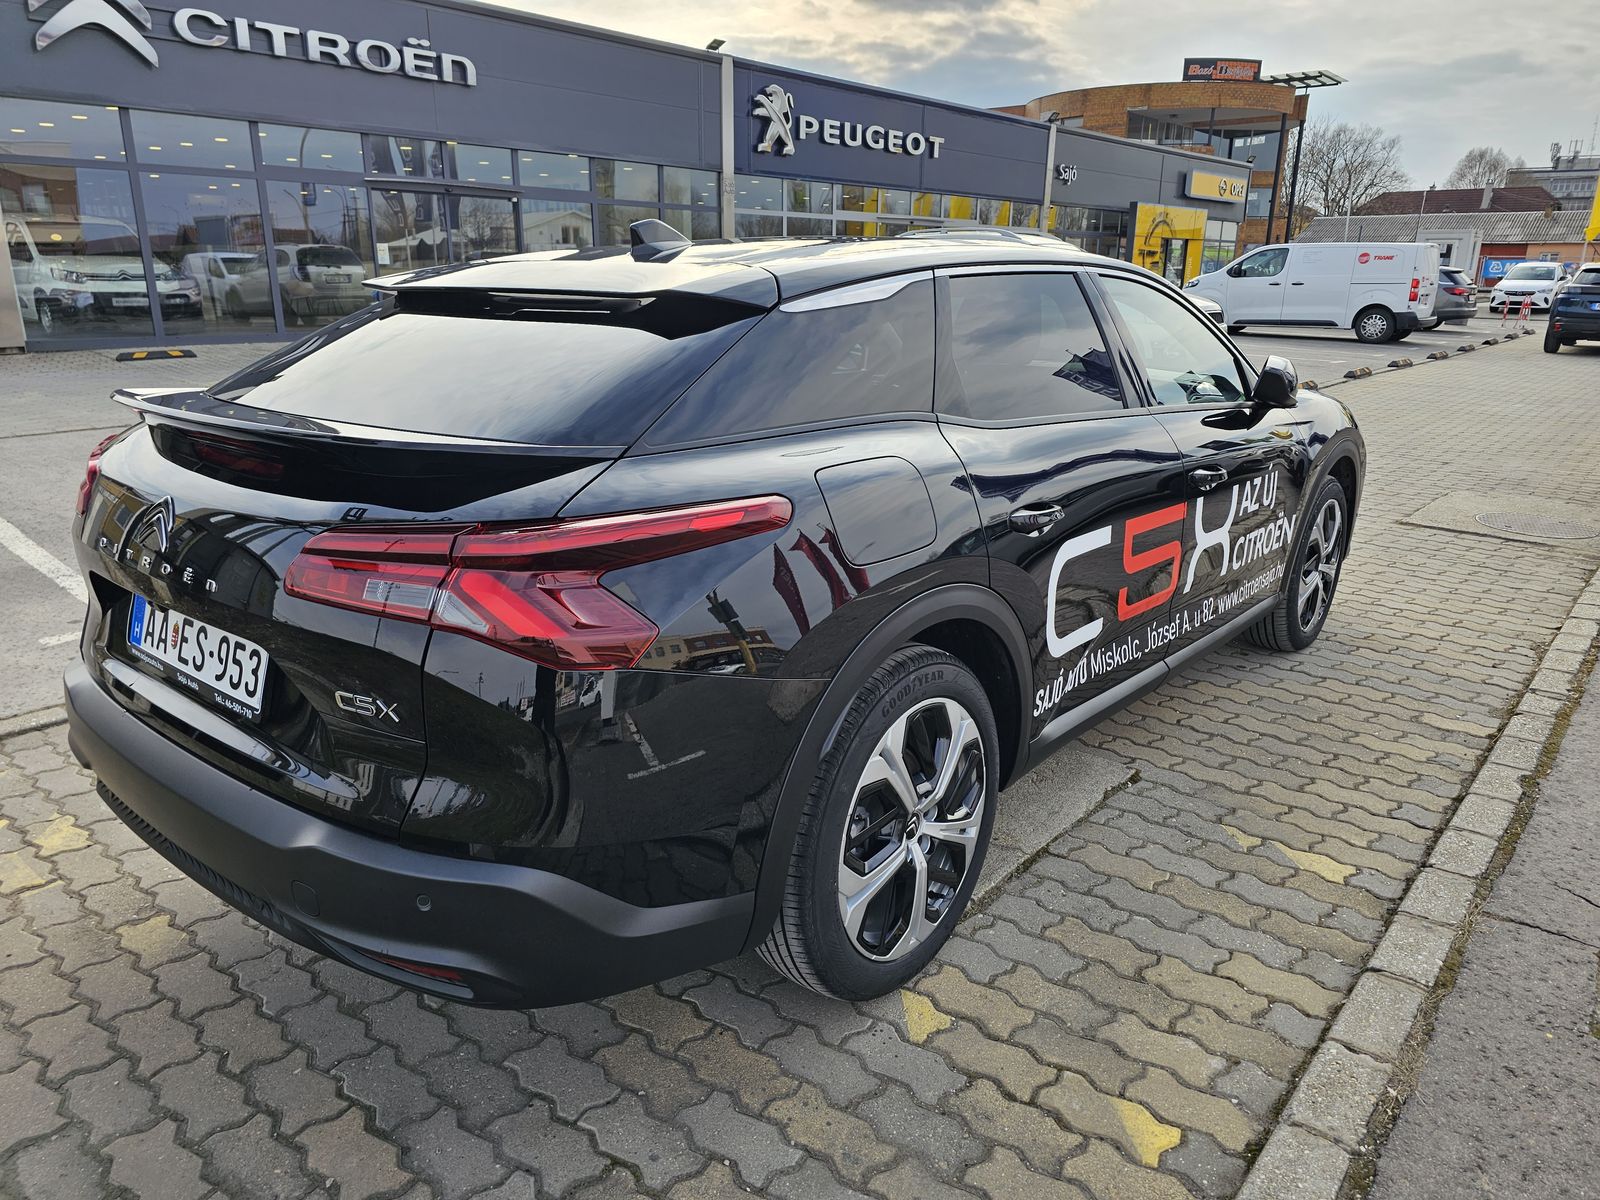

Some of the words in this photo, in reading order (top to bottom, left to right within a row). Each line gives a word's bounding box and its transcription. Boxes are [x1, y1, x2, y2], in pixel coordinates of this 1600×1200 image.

[171, 7, 478, 87] CITROËN
[799, 114, 945, 159] PEUGEOT
[1059, 163, 1077, 185] Sajó
[1239, 476, 1262, 517] AZ
[1262, 462, 1279, 511] ÚJ
[1232, 510, 1297, 571] CITROËN
[133, 620, 141, 639] H
[1033, 667, 1064, 717] SAJÓ
[1090, 635, 1143, 679] Miskolc,
[1144, 613, 1181, 653] József
[1182, 609, 1193, 635] A.
[1194, 609, 1201, 628] u
[1202, 597, 1216, 624] 82.
[1218, 561, 1286, 615] www.citroensajo.hu
[334, 690, 401, 723] C5X
[881, 669, 945, 718] GOODYEAR
